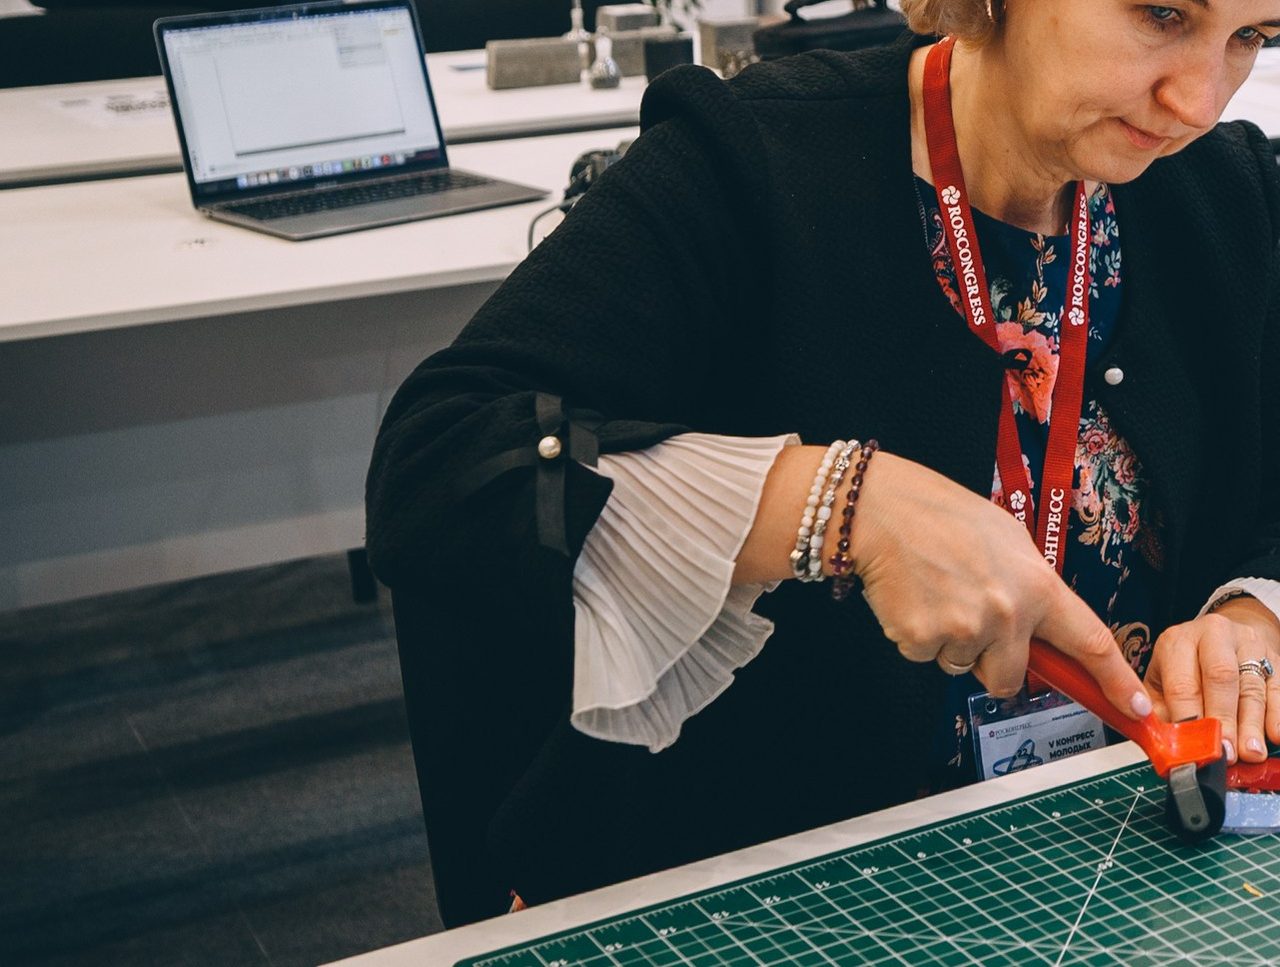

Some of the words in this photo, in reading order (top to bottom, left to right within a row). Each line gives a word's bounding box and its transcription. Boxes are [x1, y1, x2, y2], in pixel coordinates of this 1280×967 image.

[948, 205, 986, 326] ROSCONGRESS
[1071, 193, 1088, 308] ROSCONGRESS
[1044, 488, 1065, 570] ОНГРЕСС
[1048, 740, 1055, 748] V
[1056, 730, 1095, 747] КОНГРЕСС
[1049, 743, 1091, 759] МОЛОДЫХ
